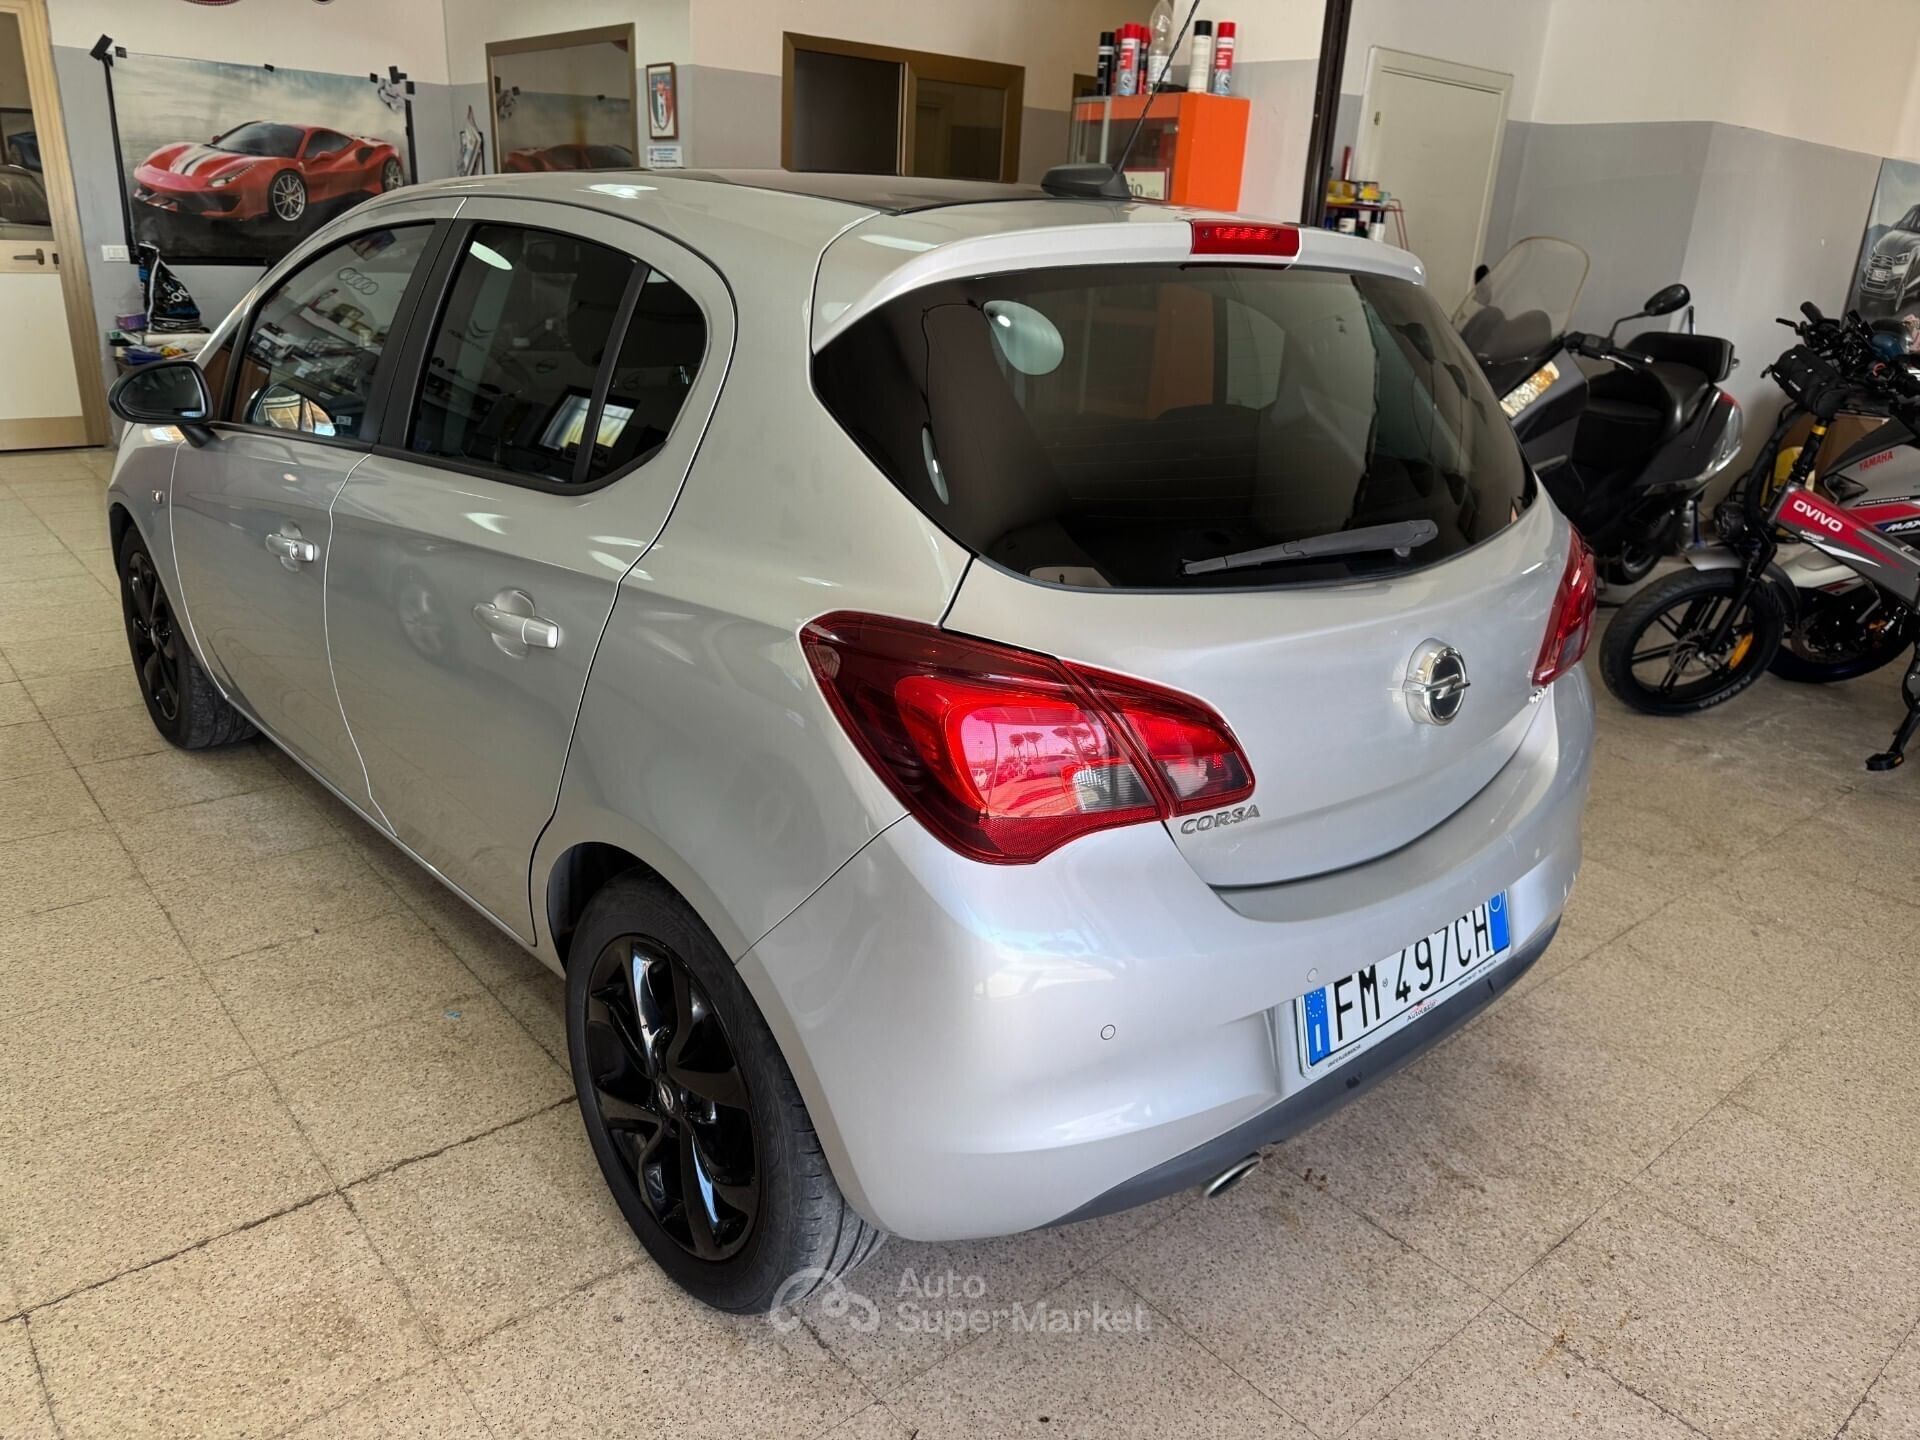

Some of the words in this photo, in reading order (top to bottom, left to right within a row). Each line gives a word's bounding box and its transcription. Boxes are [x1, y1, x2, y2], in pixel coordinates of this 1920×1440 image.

[1859, 451, 1893, 471] YAMAHA
[1793, 499, 1843, 532] OVIVO
[1181, 804, 1260, 834] CORSA
[1334, 964, 1380, 1042] FM
[1395, 904, 1489, 1003] 497CH
